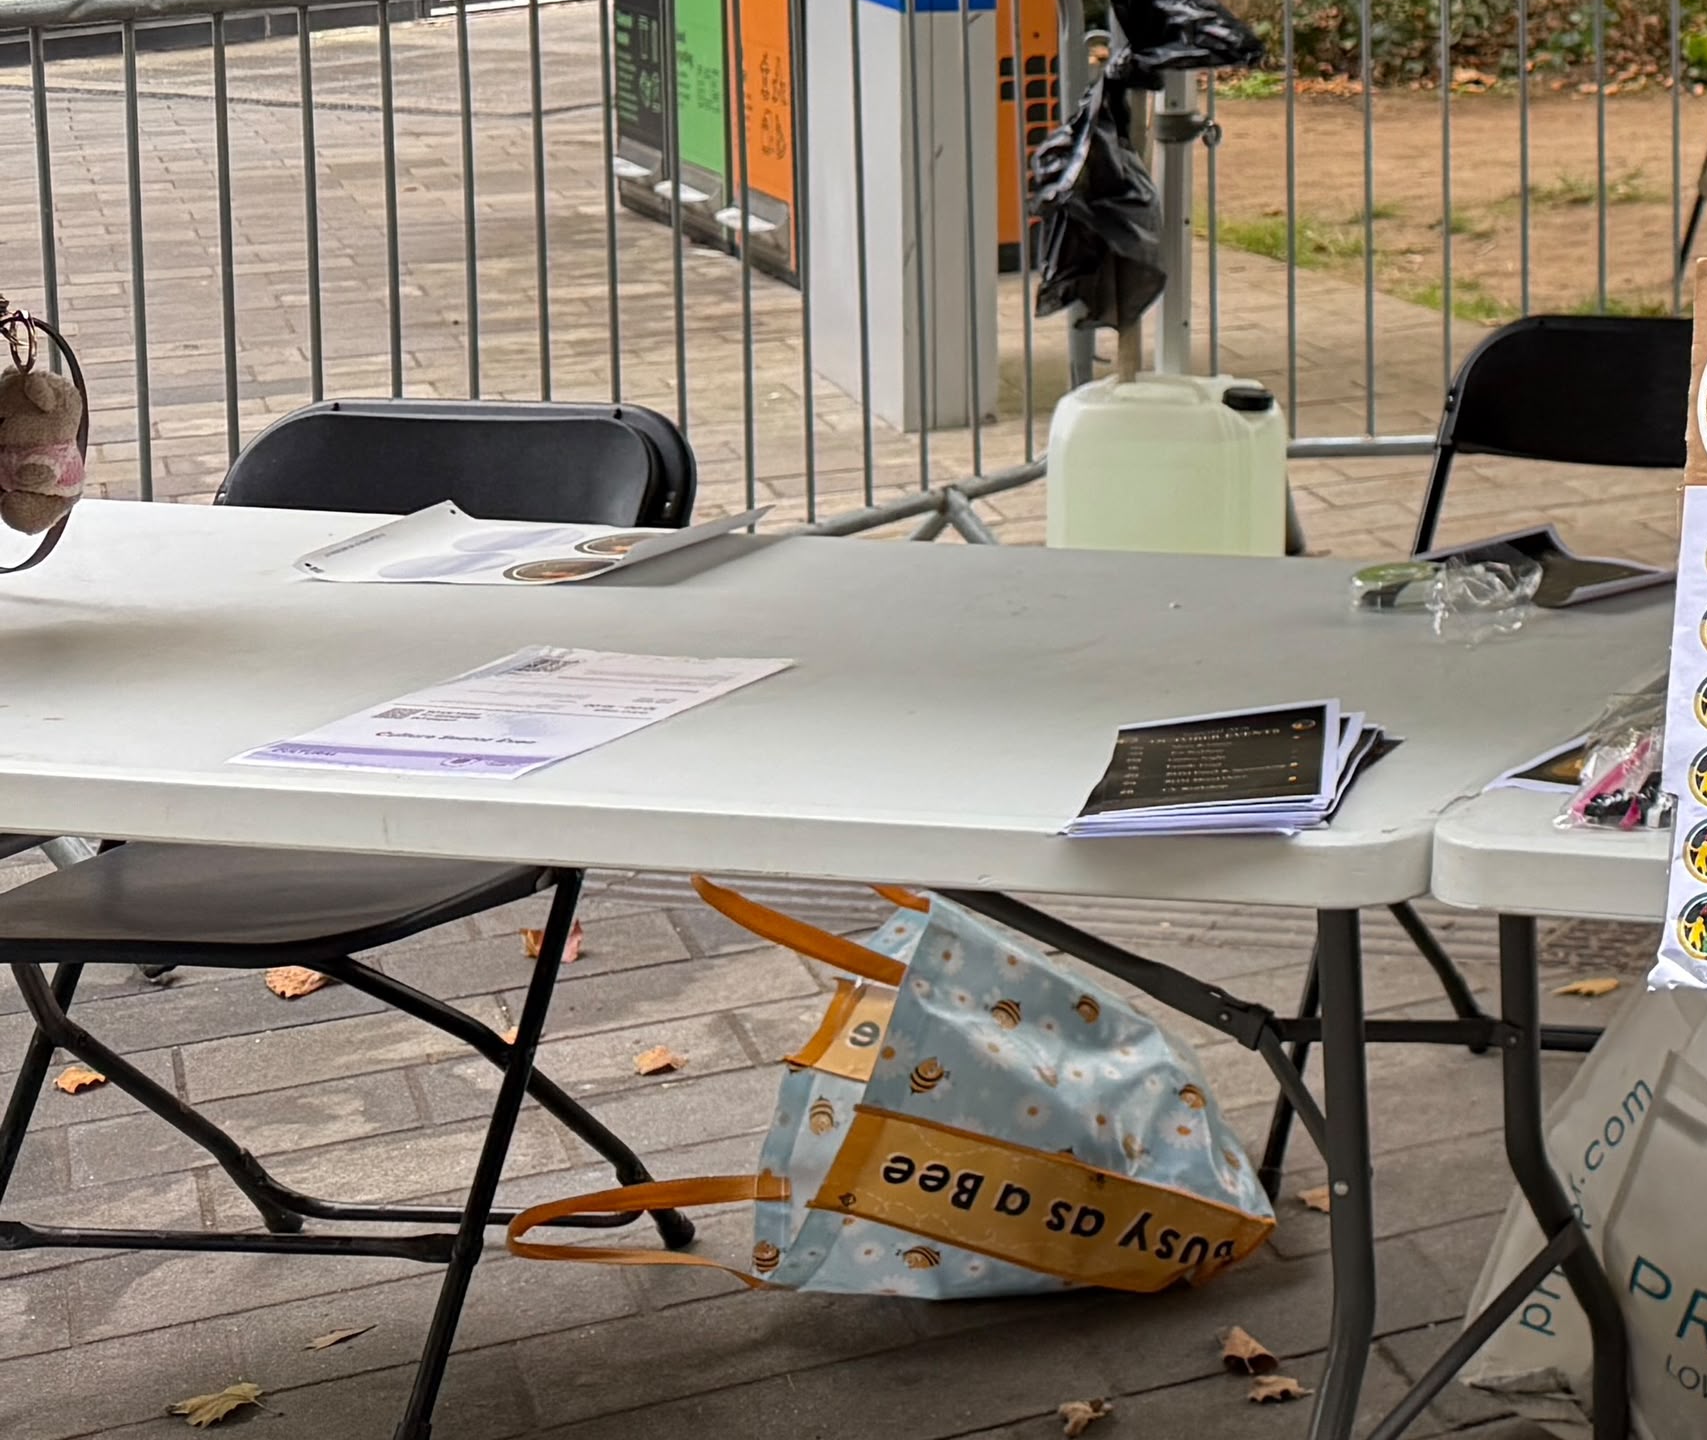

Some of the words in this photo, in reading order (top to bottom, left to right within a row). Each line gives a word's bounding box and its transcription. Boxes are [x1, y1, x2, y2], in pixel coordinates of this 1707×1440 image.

[882, 1154, 985, 1212] Bee
[994, 1182, 1031, 1217] a
[1046, 1201, 1105, 1238] as
